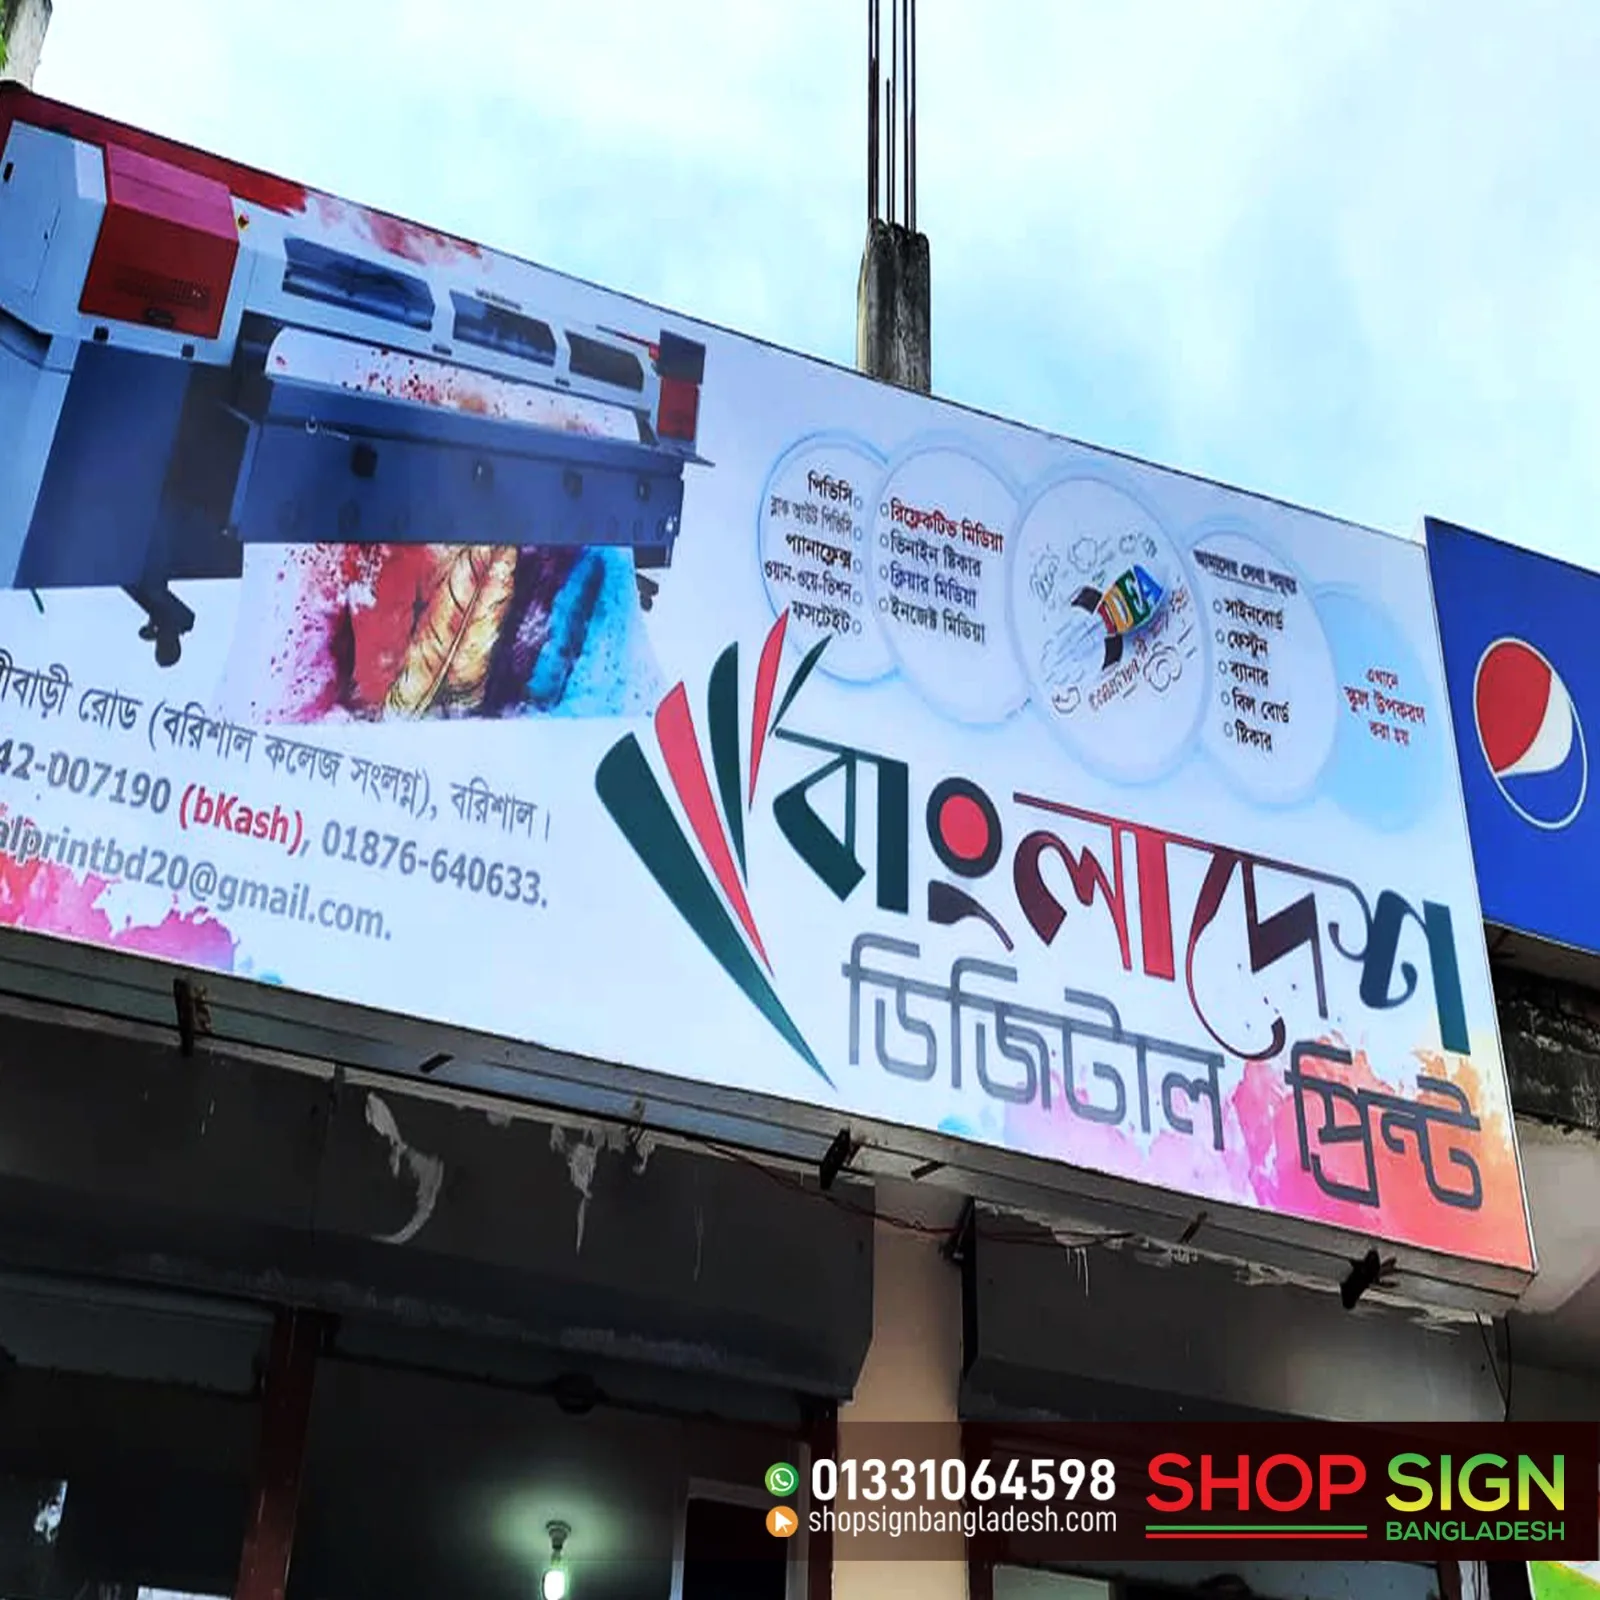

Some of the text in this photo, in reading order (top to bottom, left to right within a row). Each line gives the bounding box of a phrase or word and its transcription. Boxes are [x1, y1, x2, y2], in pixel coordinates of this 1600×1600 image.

[961, 516, 1003, 556] মিডিয়া
[934, 573, 977, 610] মিডিয়া
[1097, 563, 1163, 636] IDEA
[942, 608, 986, 646] মিডিয়া
[1228, 660, 1269, 689] ব্যানার
[1231, 685, 1291, 724] বিল বোর্ড
[78, 688, 143, 730] রোড
[149, 701, 257, 763] (বরিশাল
[264, 734, 344, 787] কলেজ
[179, 784, 311, 857] (bKash),
[321, 819, 549, 908] 01876-640633.
[772, 727, 1471, 1061] বাংলাদেশ
[841, 931, 1484, 1210] ডিজিটাল প্রিন্ট
